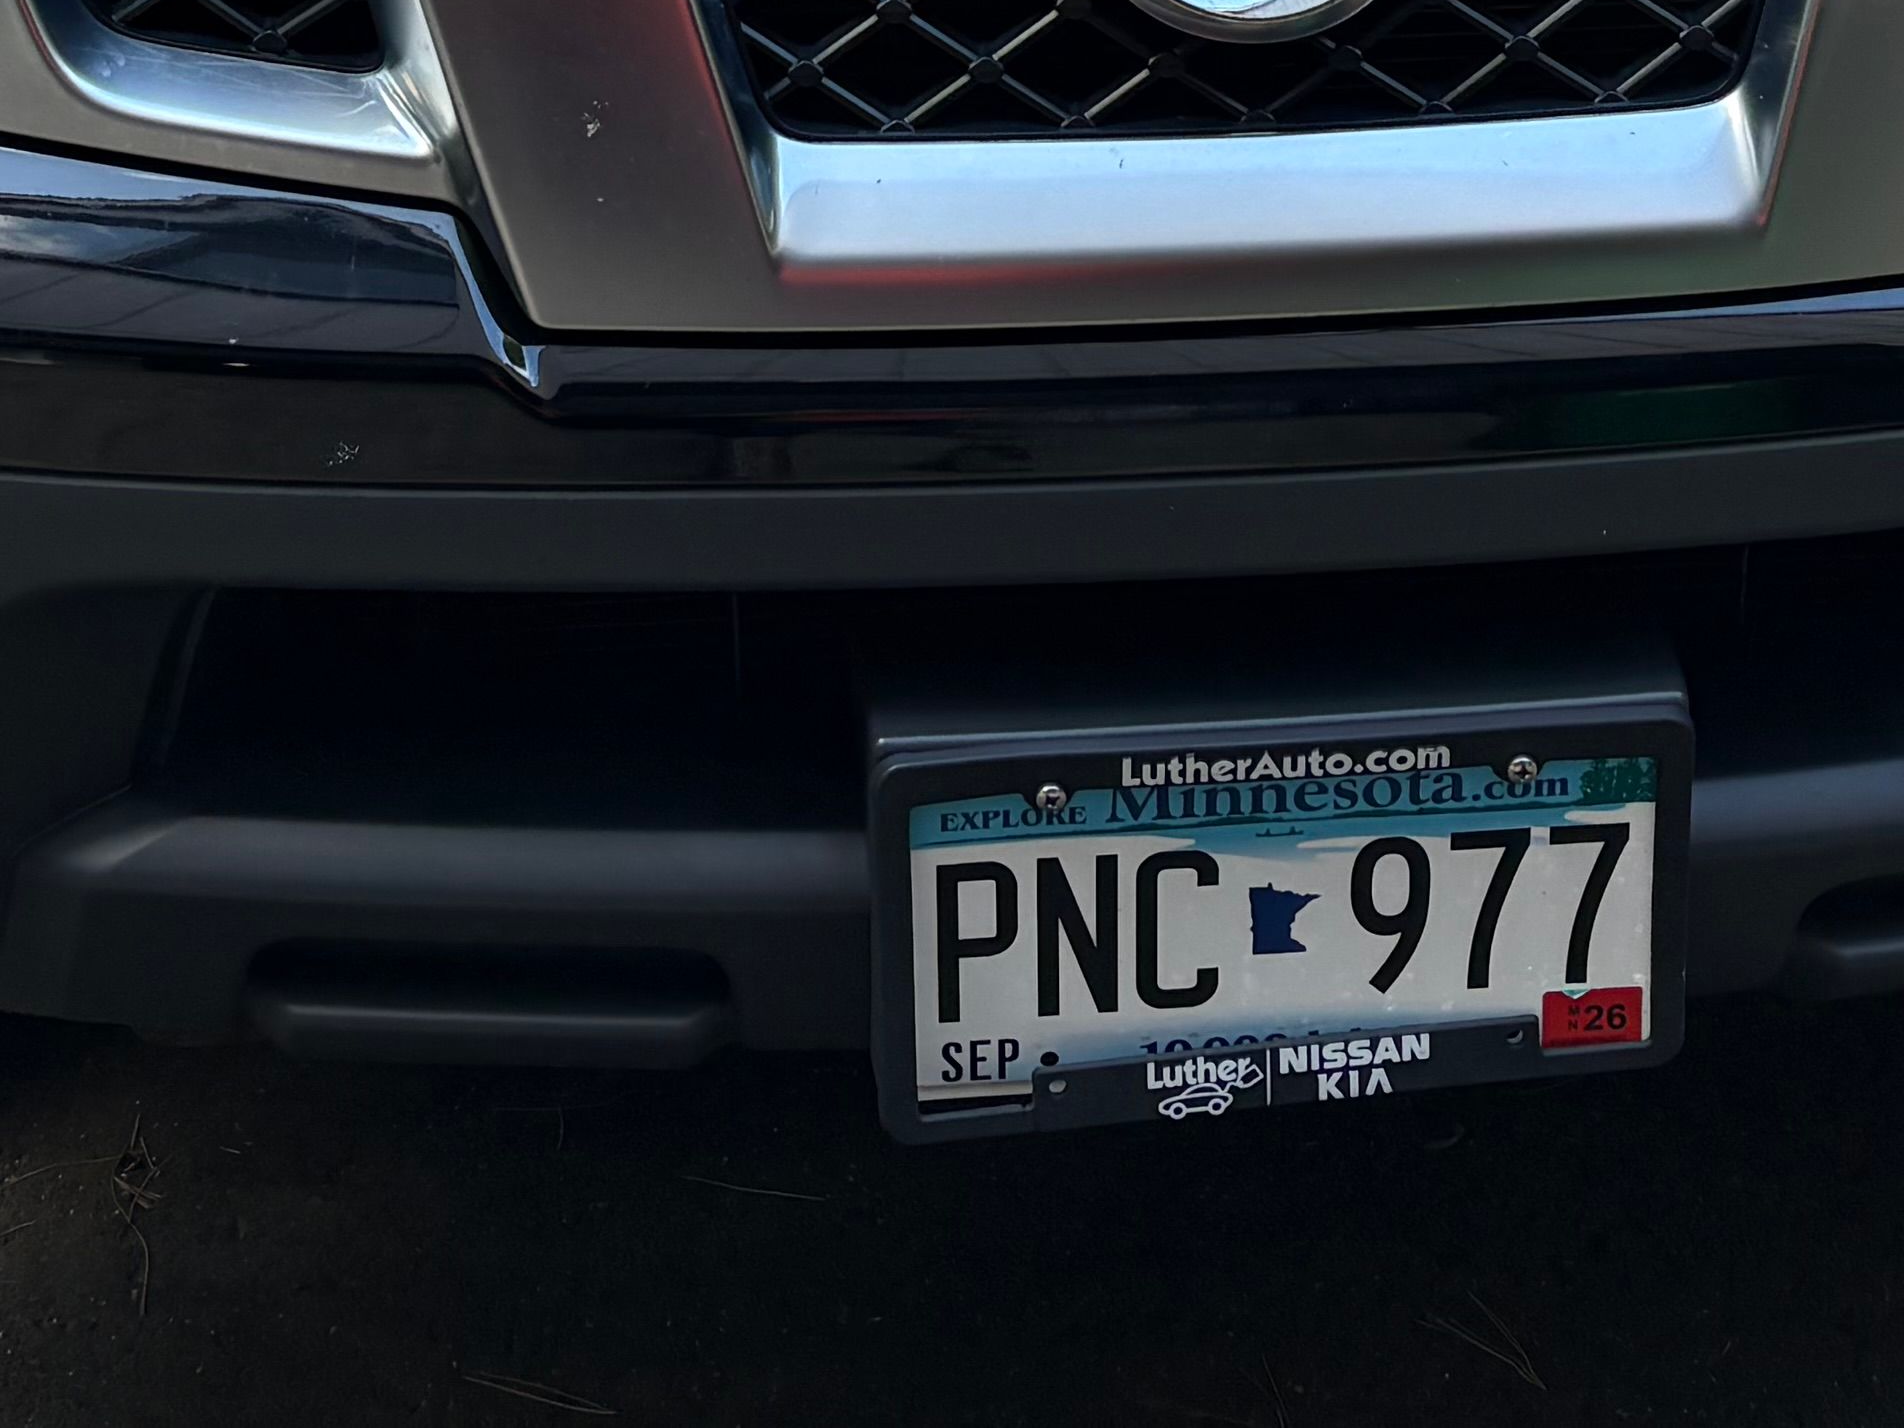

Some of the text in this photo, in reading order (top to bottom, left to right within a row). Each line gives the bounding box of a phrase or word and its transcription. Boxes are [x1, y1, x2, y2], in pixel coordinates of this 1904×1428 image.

[1121, 745, 1451, 787] LutherAuto.com
[940, 769, 1570, 833] EXPLORE Minnesota.com
[936, 822, 1631, 1023] PNC 977
[1583, 1003, 1628, 1032] 26
[941, 1038, 1020, 1083] SEP
[1146, 1056, 1253, 1090] Luther
[1279, 1032, 1430, 1075] NISSAN
[1317, 1068, 1393, 1102] KIA
